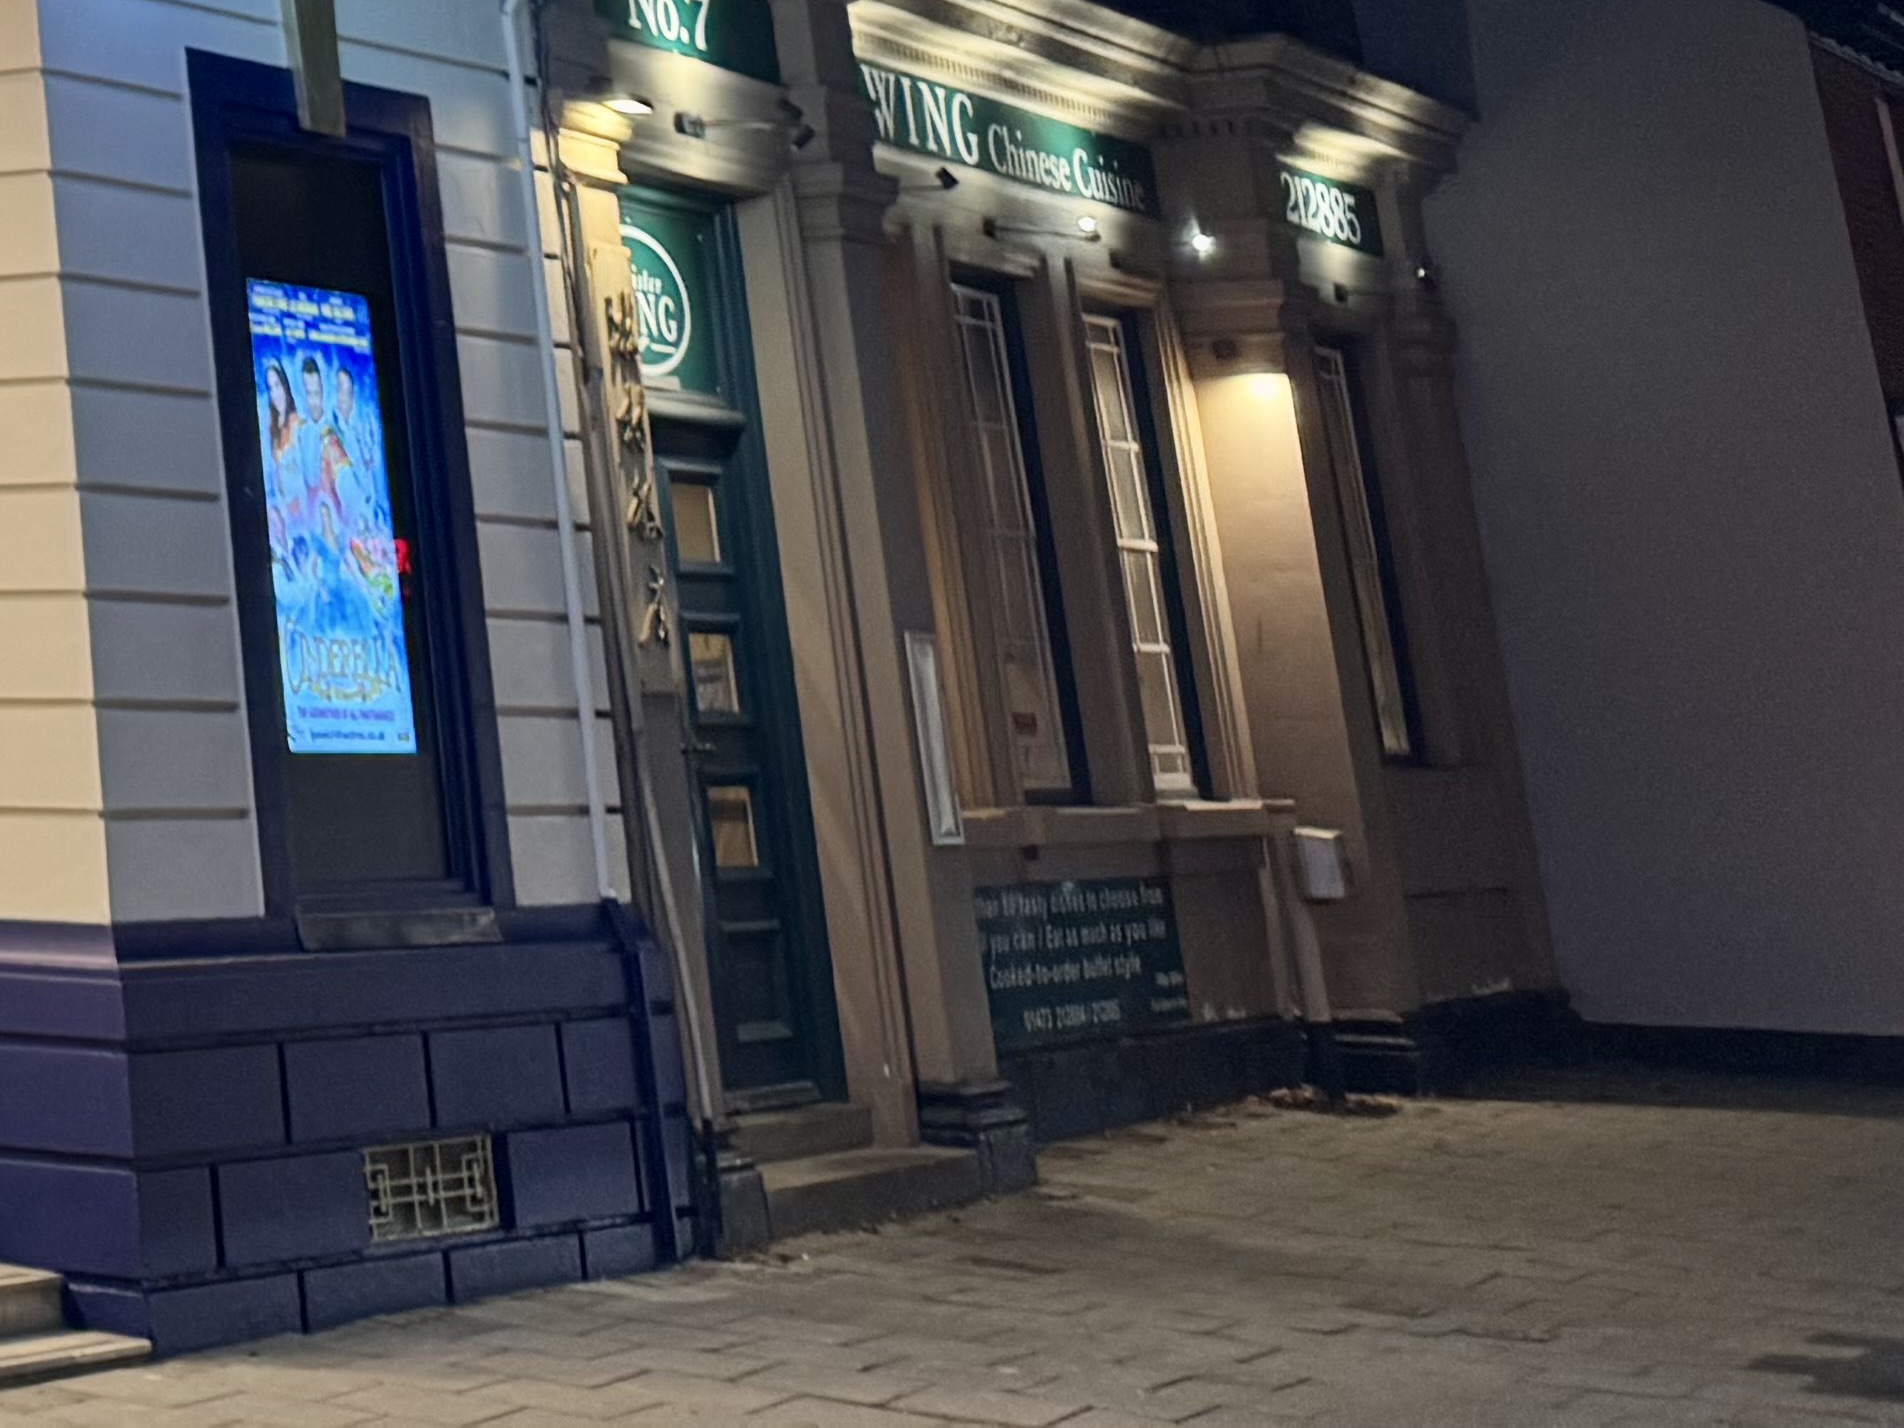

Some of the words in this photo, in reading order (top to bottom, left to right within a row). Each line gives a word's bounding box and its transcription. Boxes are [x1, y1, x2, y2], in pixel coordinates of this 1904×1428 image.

[860, 64, 979, 165] WING
[988, 124, 1072, 192] Chinese
[1072, 148, 1146, 210] Cuisine
[1280, 172, 1361, 244] 212885
